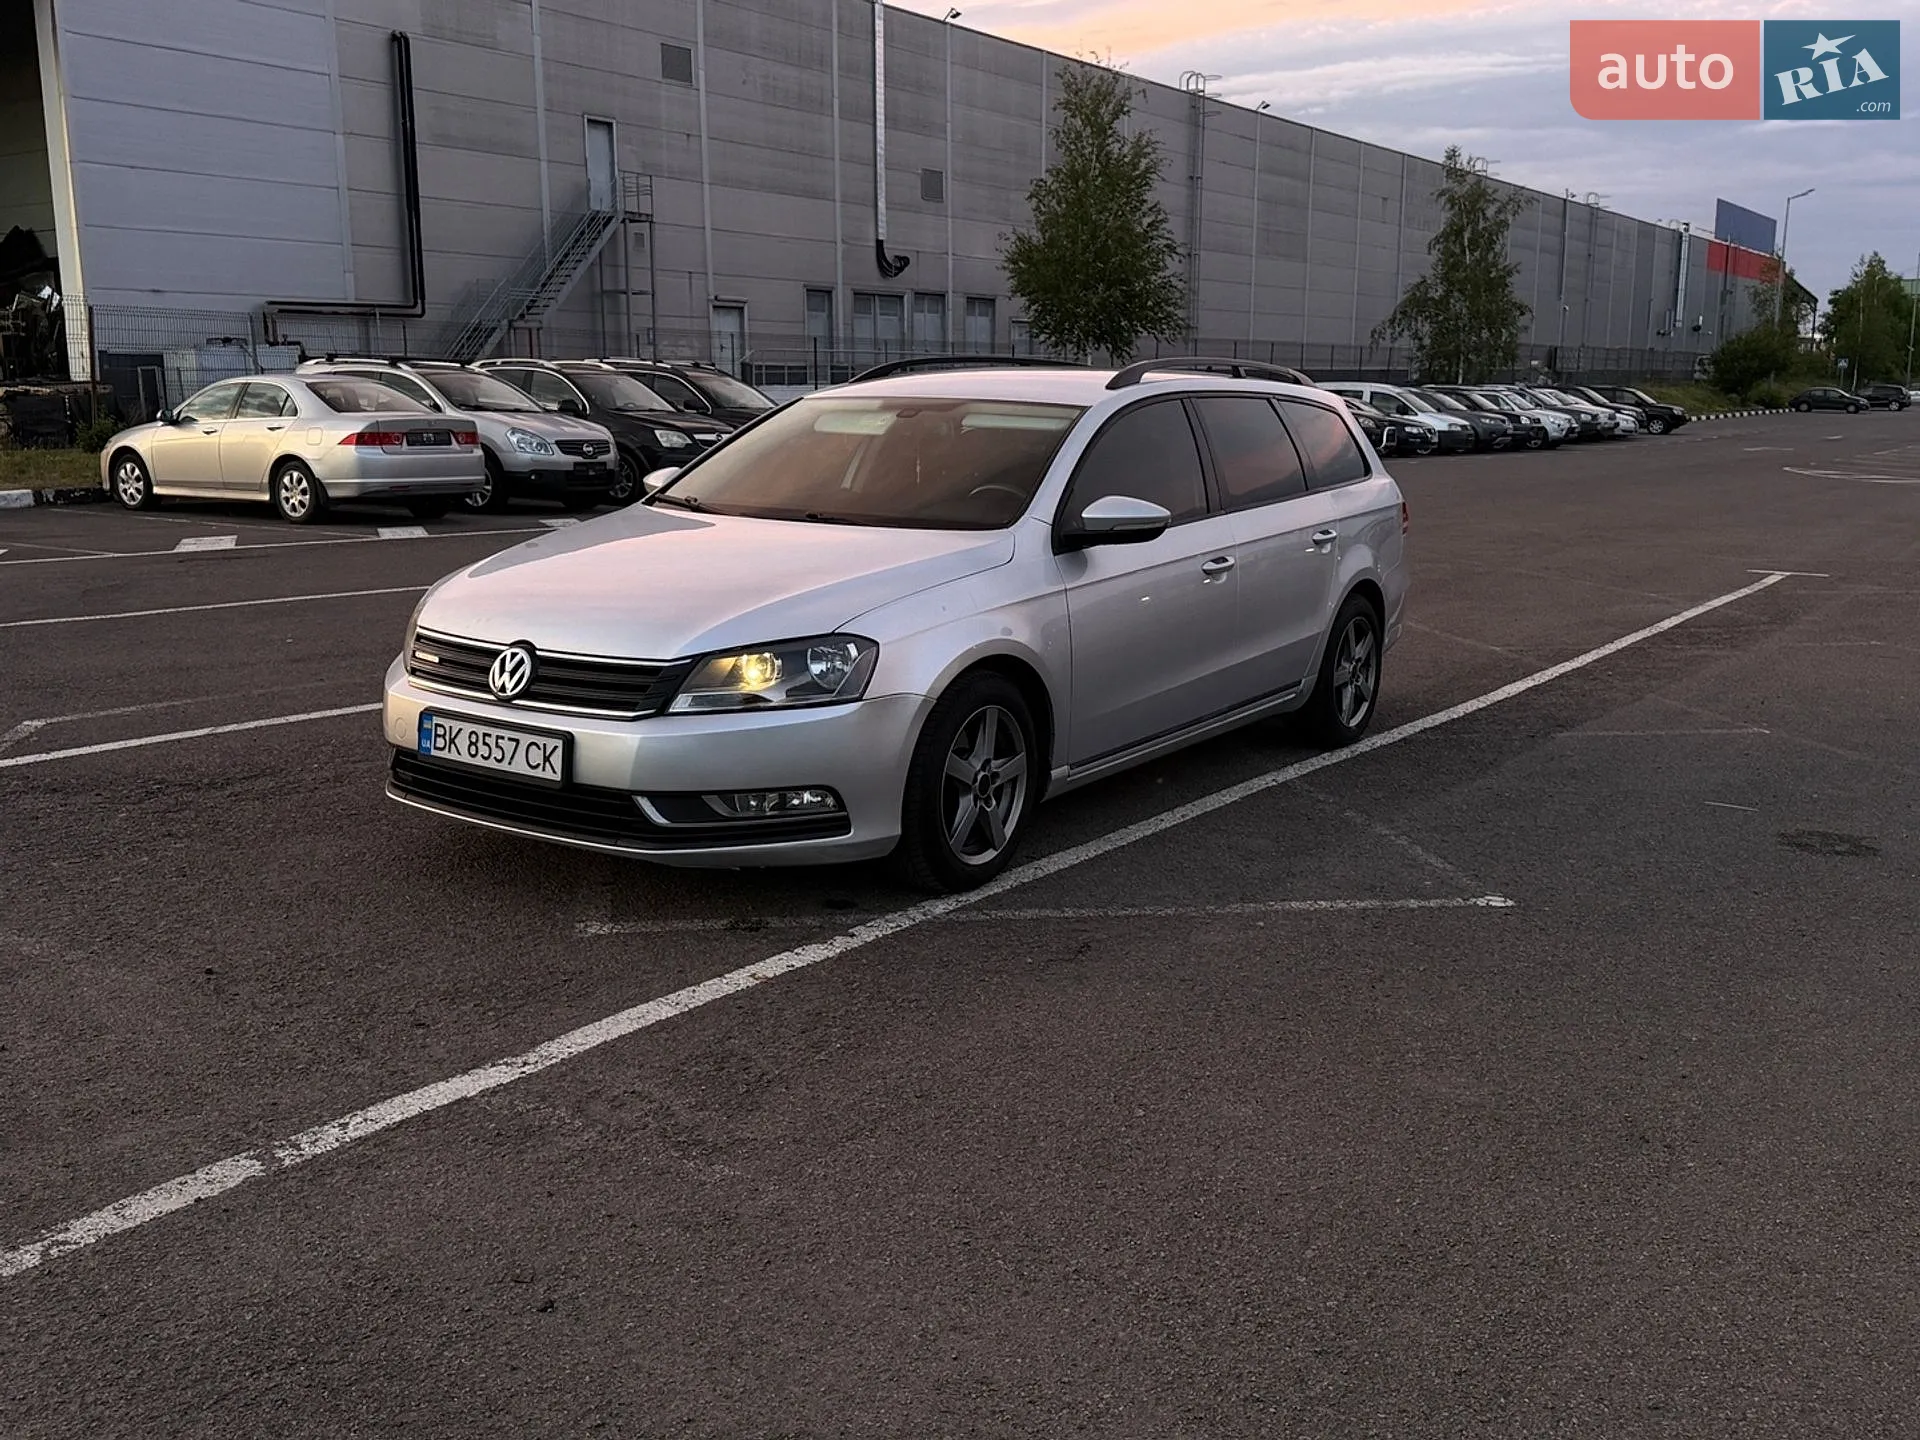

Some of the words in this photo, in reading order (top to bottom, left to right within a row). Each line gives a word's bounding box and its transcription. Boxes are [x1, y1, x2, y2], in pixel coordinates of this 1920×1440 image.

[421, 739, 431, 749] UA
[433, 722, 463, 756] BK
[467, 730, 520, 766] 8557
[525, 741, 559, 775] CK
